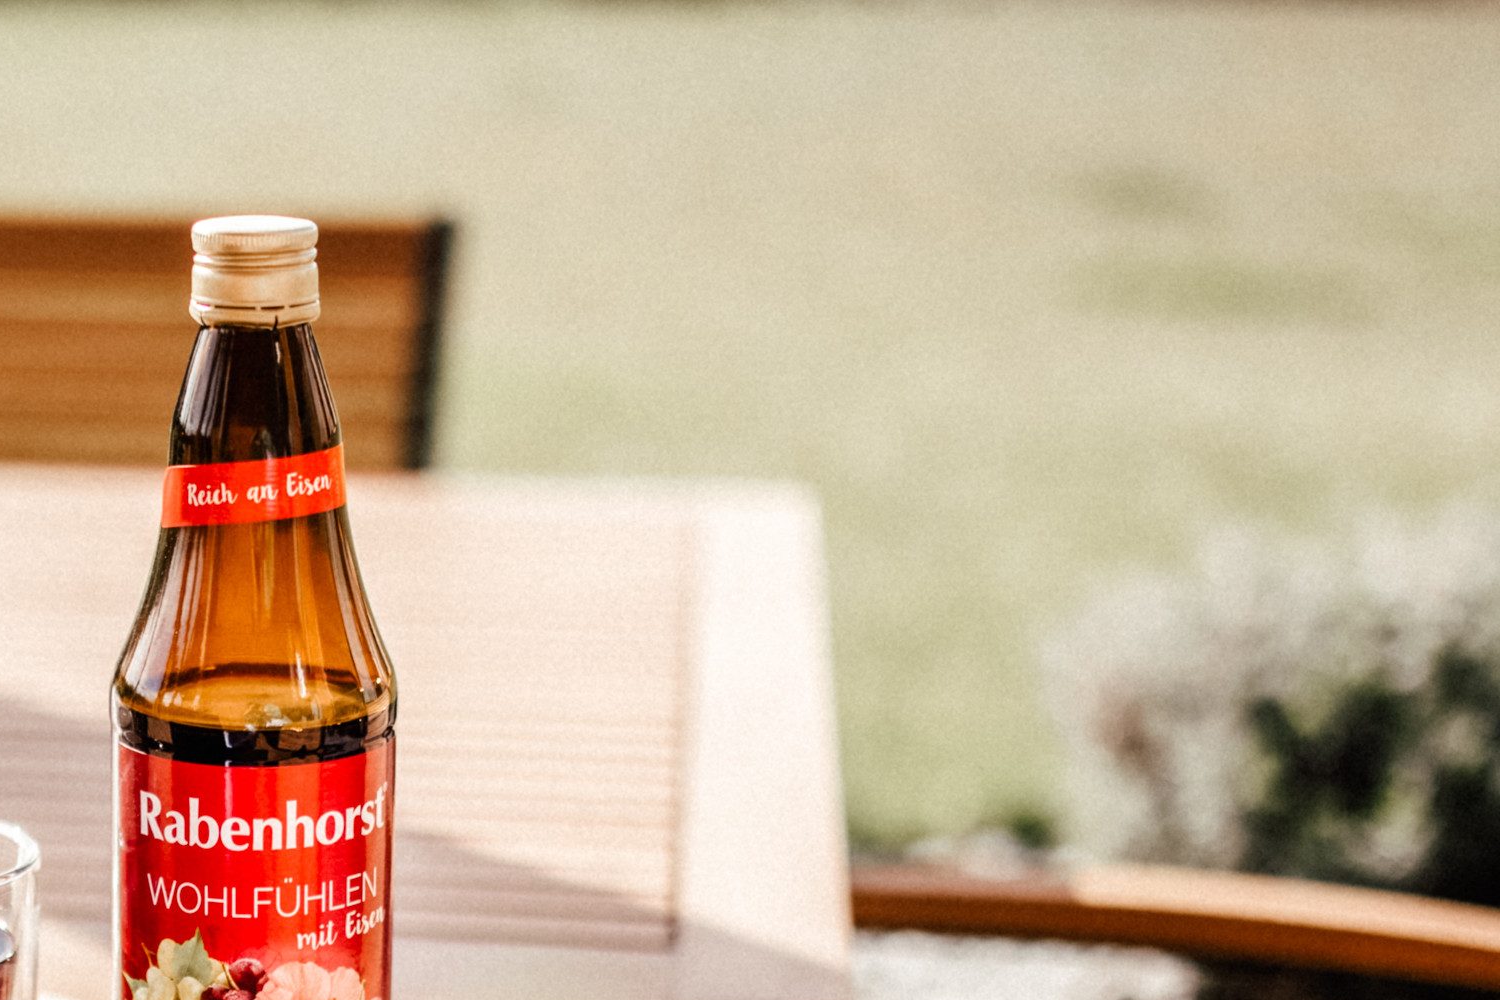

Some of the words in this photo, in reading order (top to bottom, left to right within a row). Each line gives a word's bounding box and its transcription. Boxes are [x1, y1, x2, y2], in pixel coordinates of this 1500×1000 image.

[187, 482, 237, 506] Reich
[247, 483, 278, 503] an
[286, 472, 332, 497] Eisen
[140, 785, 385, 852] Rabenhorst
[147, 867, 378, 918] WOHLFÜHLEN
[297, 921, 337, 950] mit
[345, 906, 385, 939] Eisen
